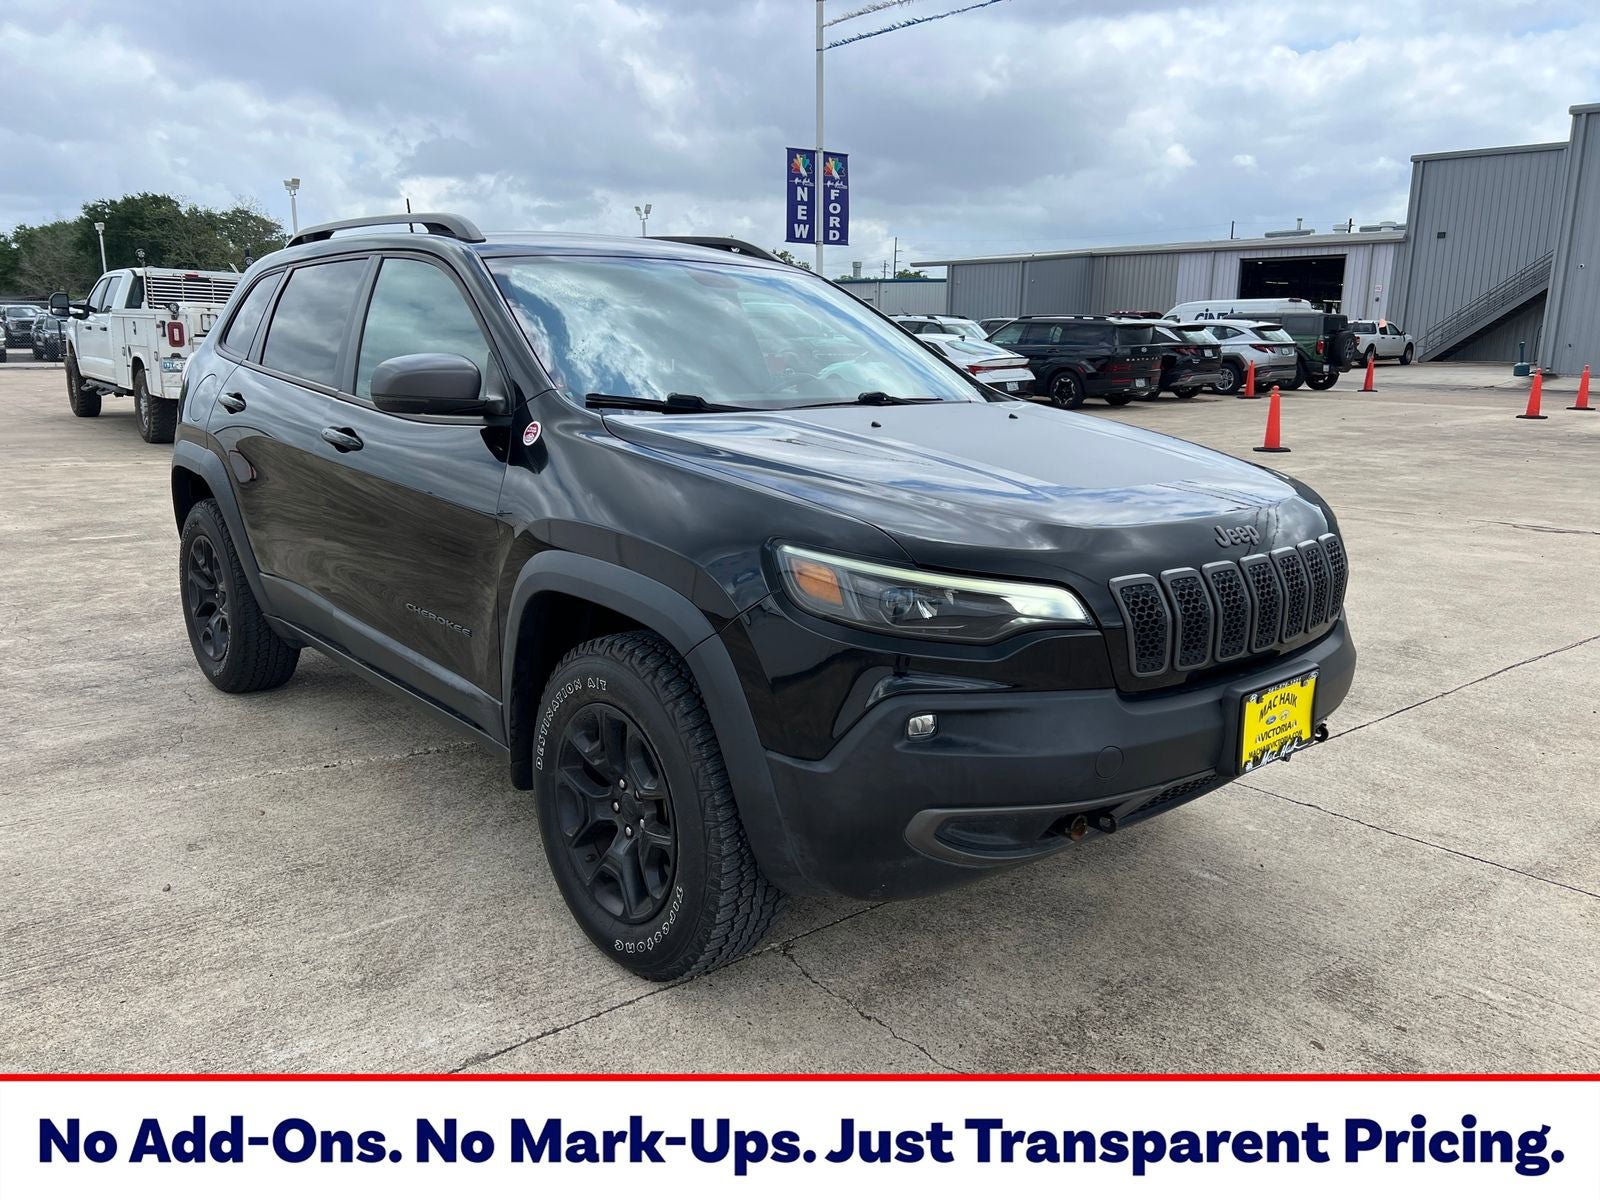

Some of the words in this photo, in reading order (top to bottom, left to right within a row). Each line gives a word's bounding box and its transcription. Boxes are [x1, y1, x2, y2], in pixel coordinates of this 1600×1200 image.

[794, 186, 809, 239] NEW
[828, 189, 841, 241] FORD
[1214, 525, 1260, 548] Jeep
[406, 603, 472, 638] CHEROKEE
[1259, 694, 1279, 720] MAC
[1279, 691, 1298, 707] HAIK
[536, 679, 582, 770] DESTINATION
[587, 677, 607, 691] A/T
[1260, 722, 1292, 742] VICTORIA
